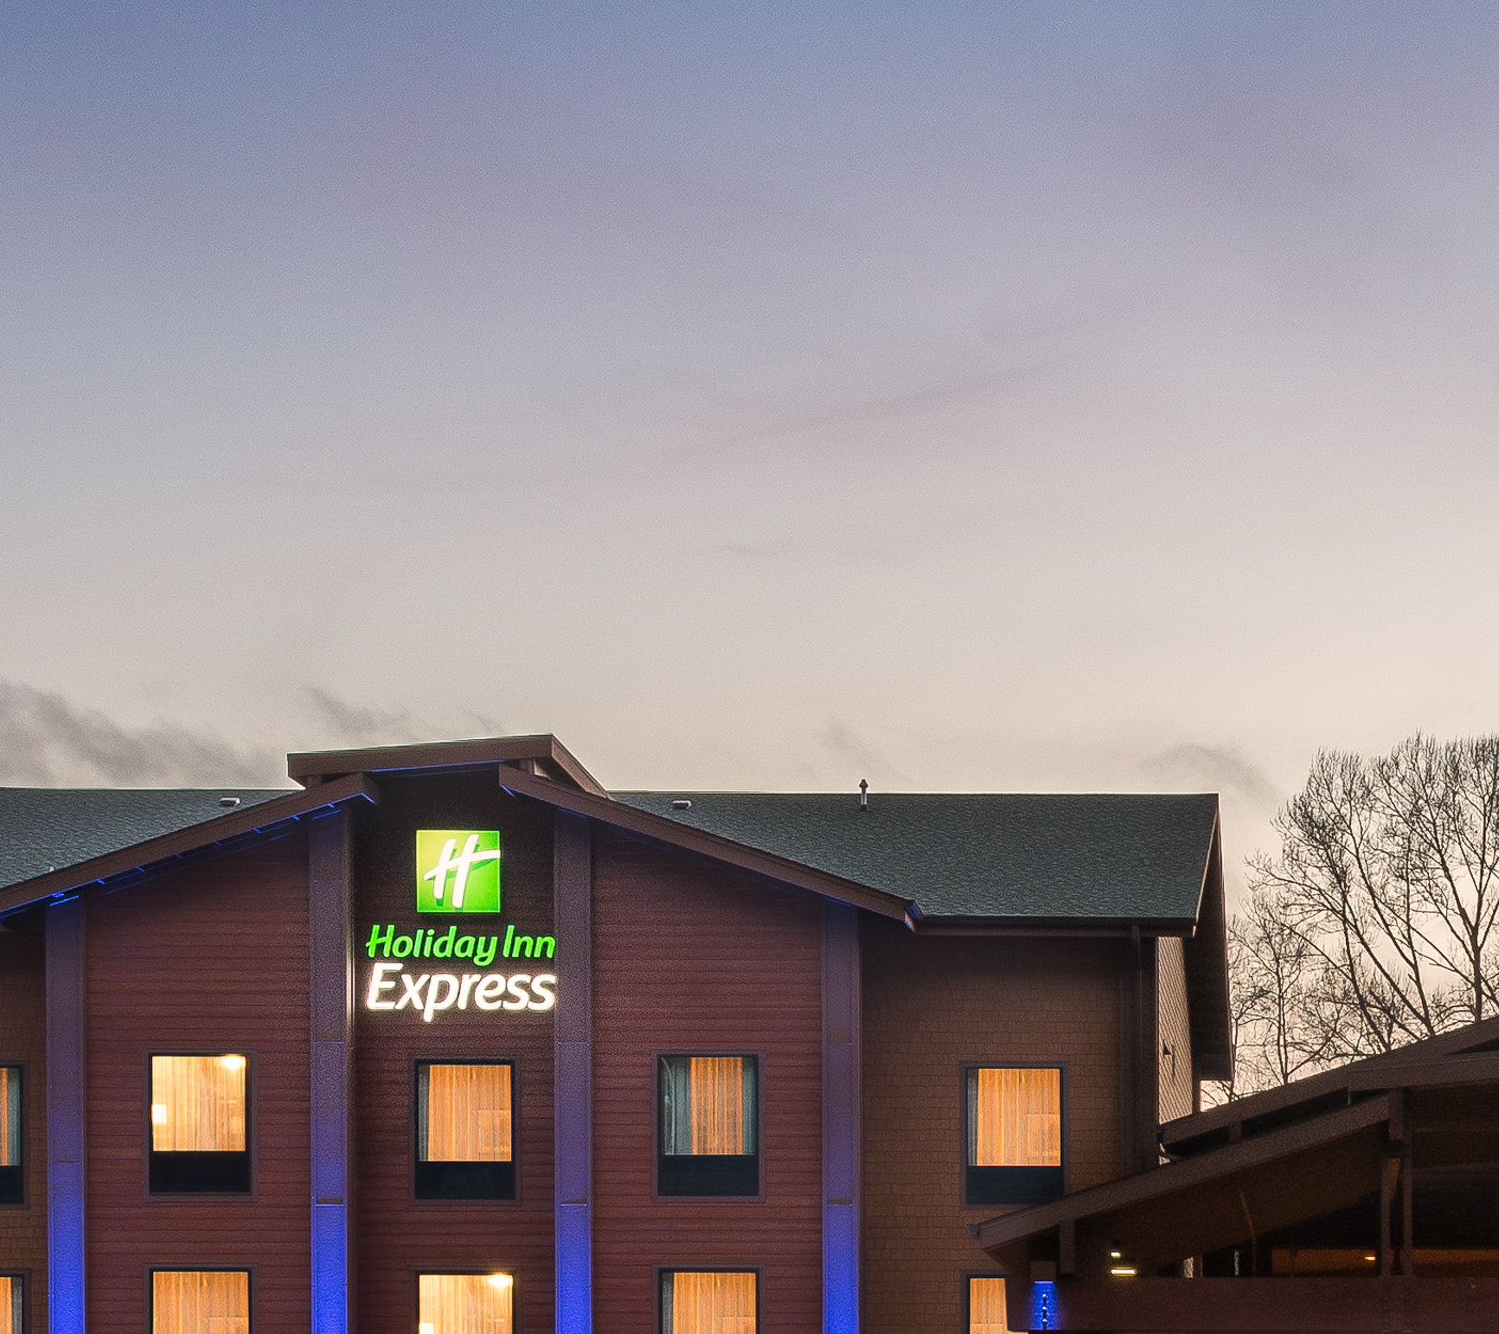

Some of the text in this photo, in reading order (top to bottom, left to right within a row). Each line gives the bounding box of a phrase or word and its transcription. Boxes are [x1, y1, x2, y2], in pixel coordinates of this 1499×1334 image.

[365, 924, 556, 966] Holiday Inn
[366, 962, 557, 1023] Express
